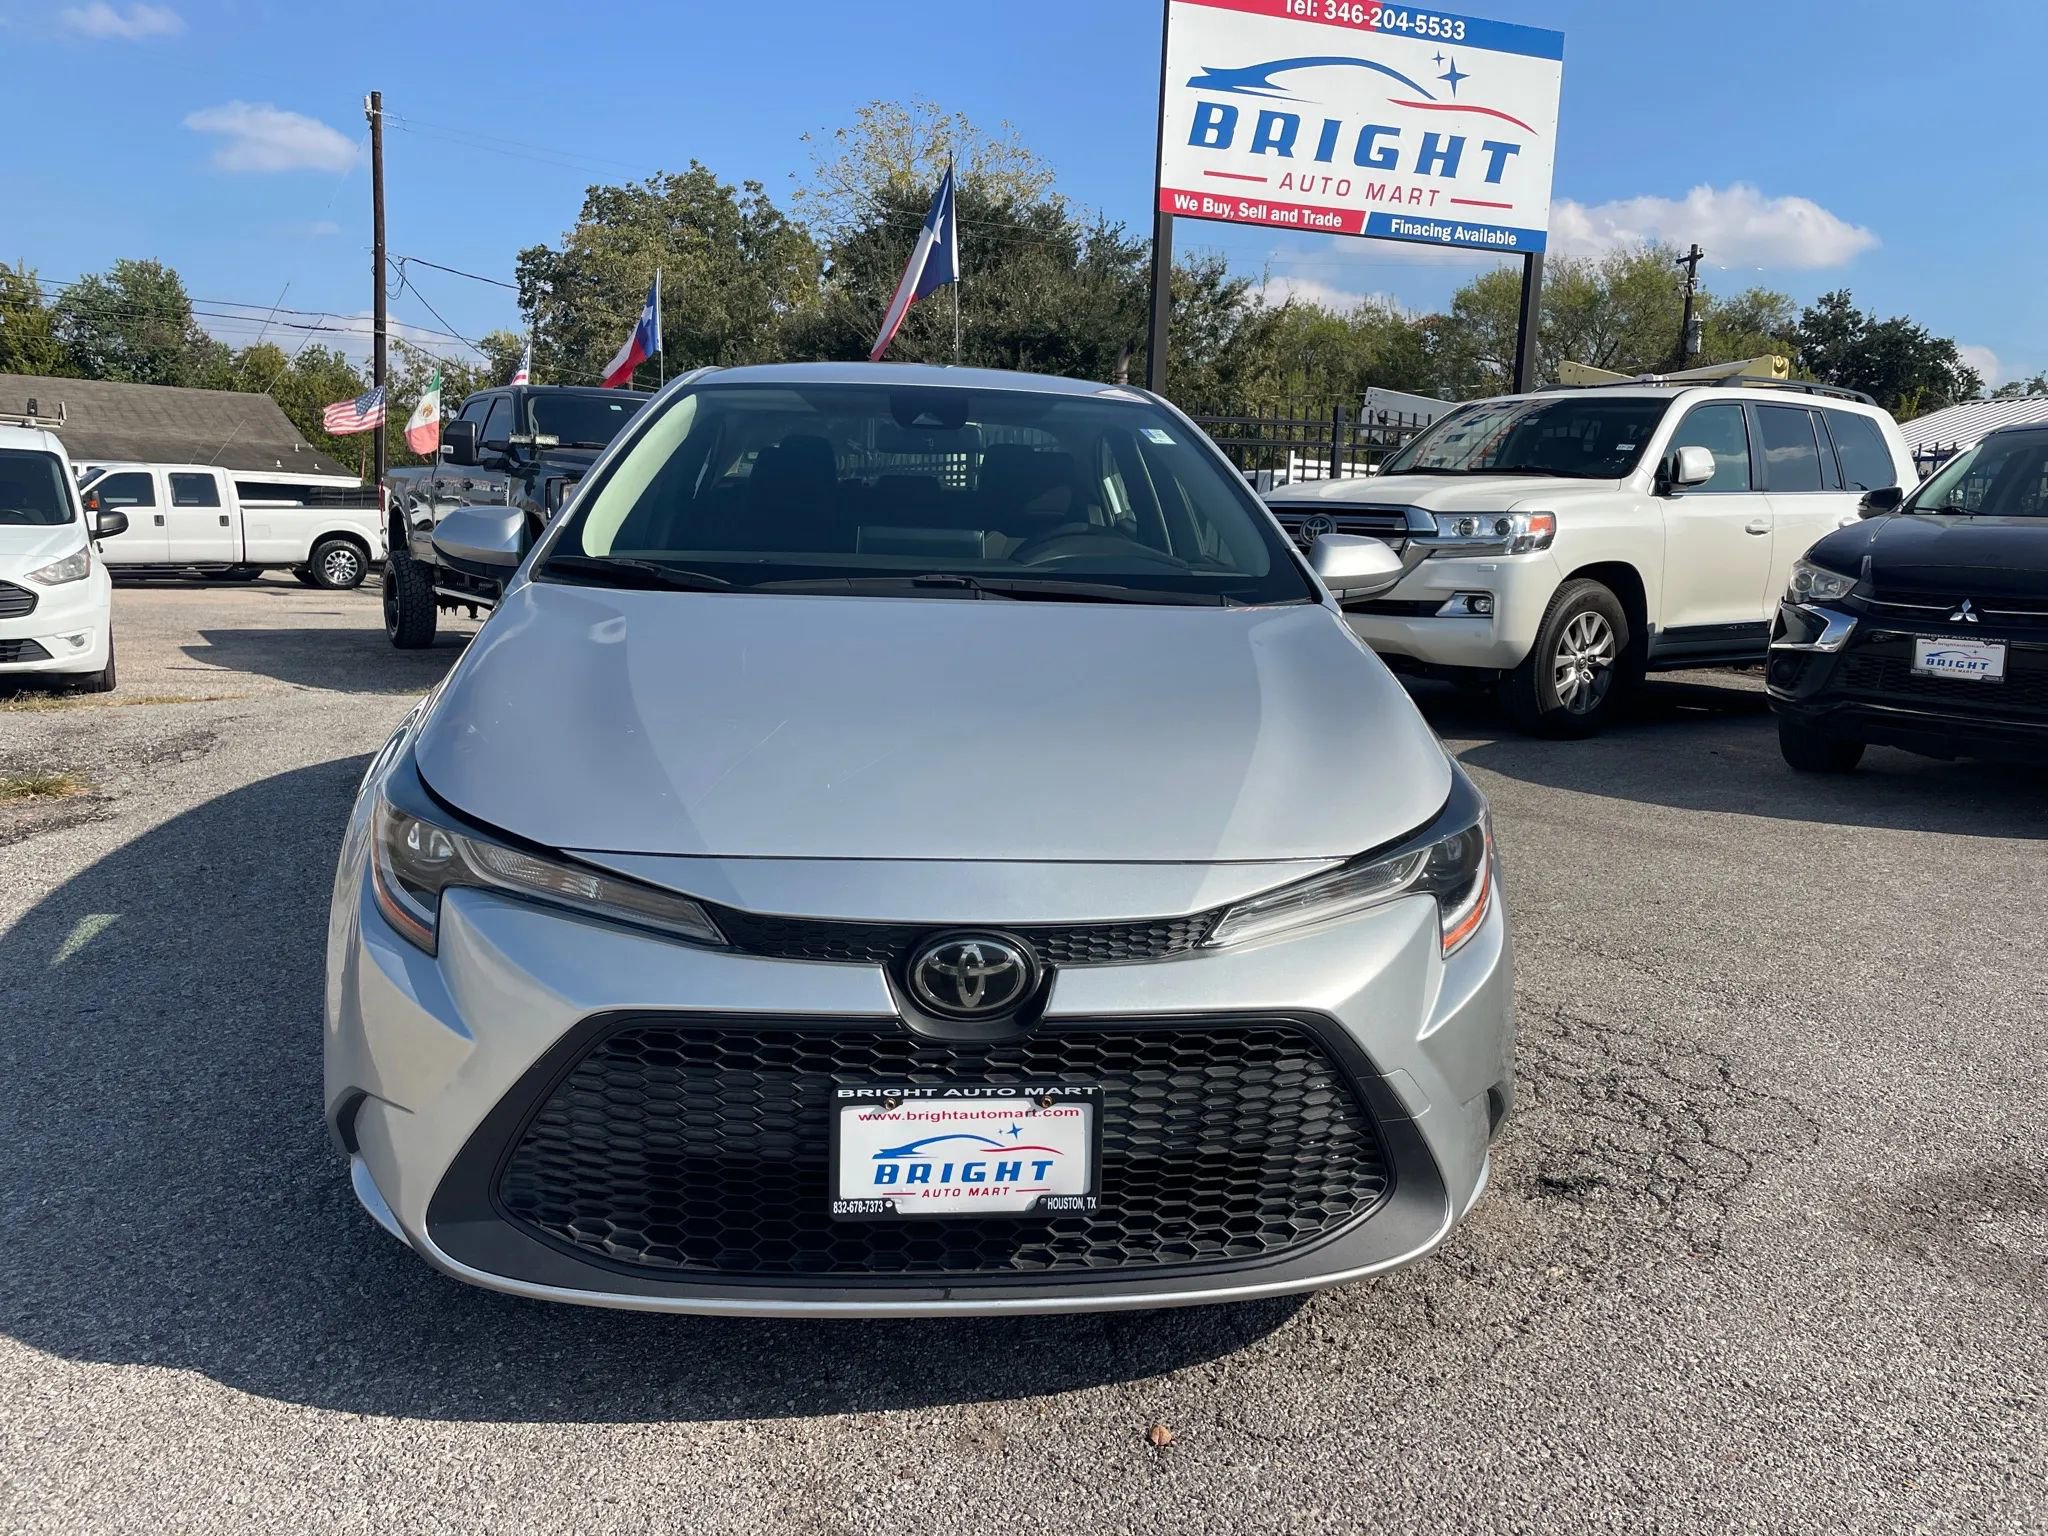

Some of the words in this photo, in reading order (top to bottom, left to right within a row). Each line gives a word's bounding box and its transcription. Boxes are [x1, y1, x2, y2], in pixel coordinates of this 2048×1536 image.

[1285, 0, 1318, 17] Tel:
[1324, 0, 1466, 40] 346-204-5533
[1187, 101, 1522, 184] BRIGHT
[1279, 172, 1352, 197] AUTO
[1365, 183, 1441, 207] MART
[1174, 194, 1198, 213] We
[1202, 199, 1235, 219] Buy,
[1238, 202, 1266, 220] Sell
[1270, 206, 1298, 224] and
[1302, 209, 1342, 228] Trade
[1390, 219, 1452, 242] Finacing
[1454, 225, 1517, 246] Available
[1926, 658, 1989, 670] BRIGHT
[837, 1088, 937, 1098] BRIGHT
[943, 1087, 1016, 1097] AUTO
[1024, 1087, 1098, 1096] MART
[858, 1108, 1079, 1123] www.brightautomart.com
[873, 1160, 1054, 1185] BRIGHT
[921, 1187, 961, 1198] AUTO
[969, 1187, 1010, 1197] MART
[833, 1201, 884, 1214] 832-678-7373
[1047, 1196, 1085, 1212] HOUSTON,
[1086, 1196, 1097, 1210] TX
